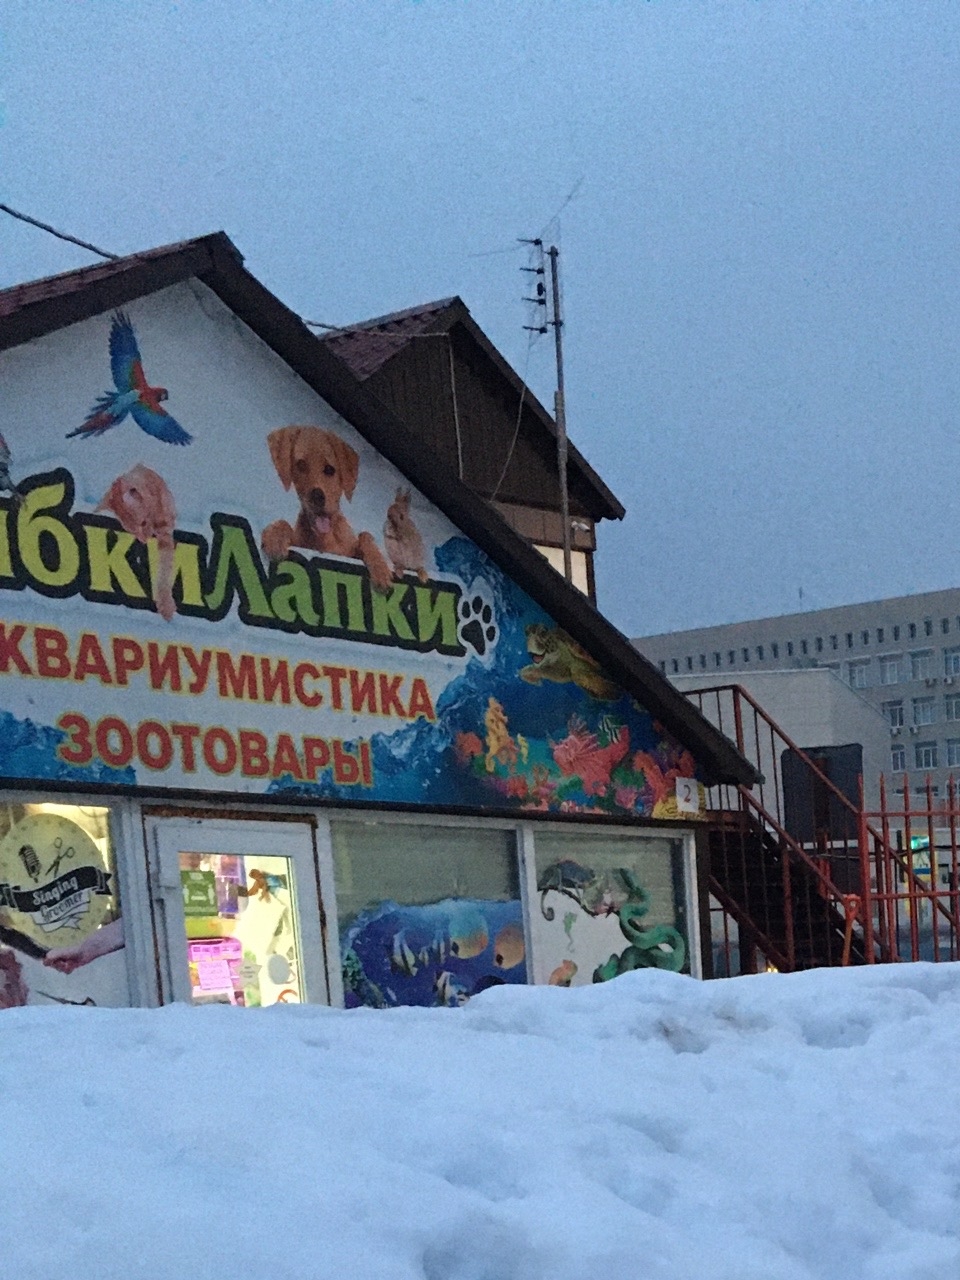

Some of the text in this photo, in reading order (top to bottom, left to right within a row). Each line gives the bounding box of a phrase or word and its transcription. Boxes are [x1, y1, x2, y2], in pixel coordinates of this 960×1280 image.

[57, 712, 373, 787] ЗООТОВАРЫ
[683, 784, 692, 804] 2
[32, 876, 79, 906] Singing
